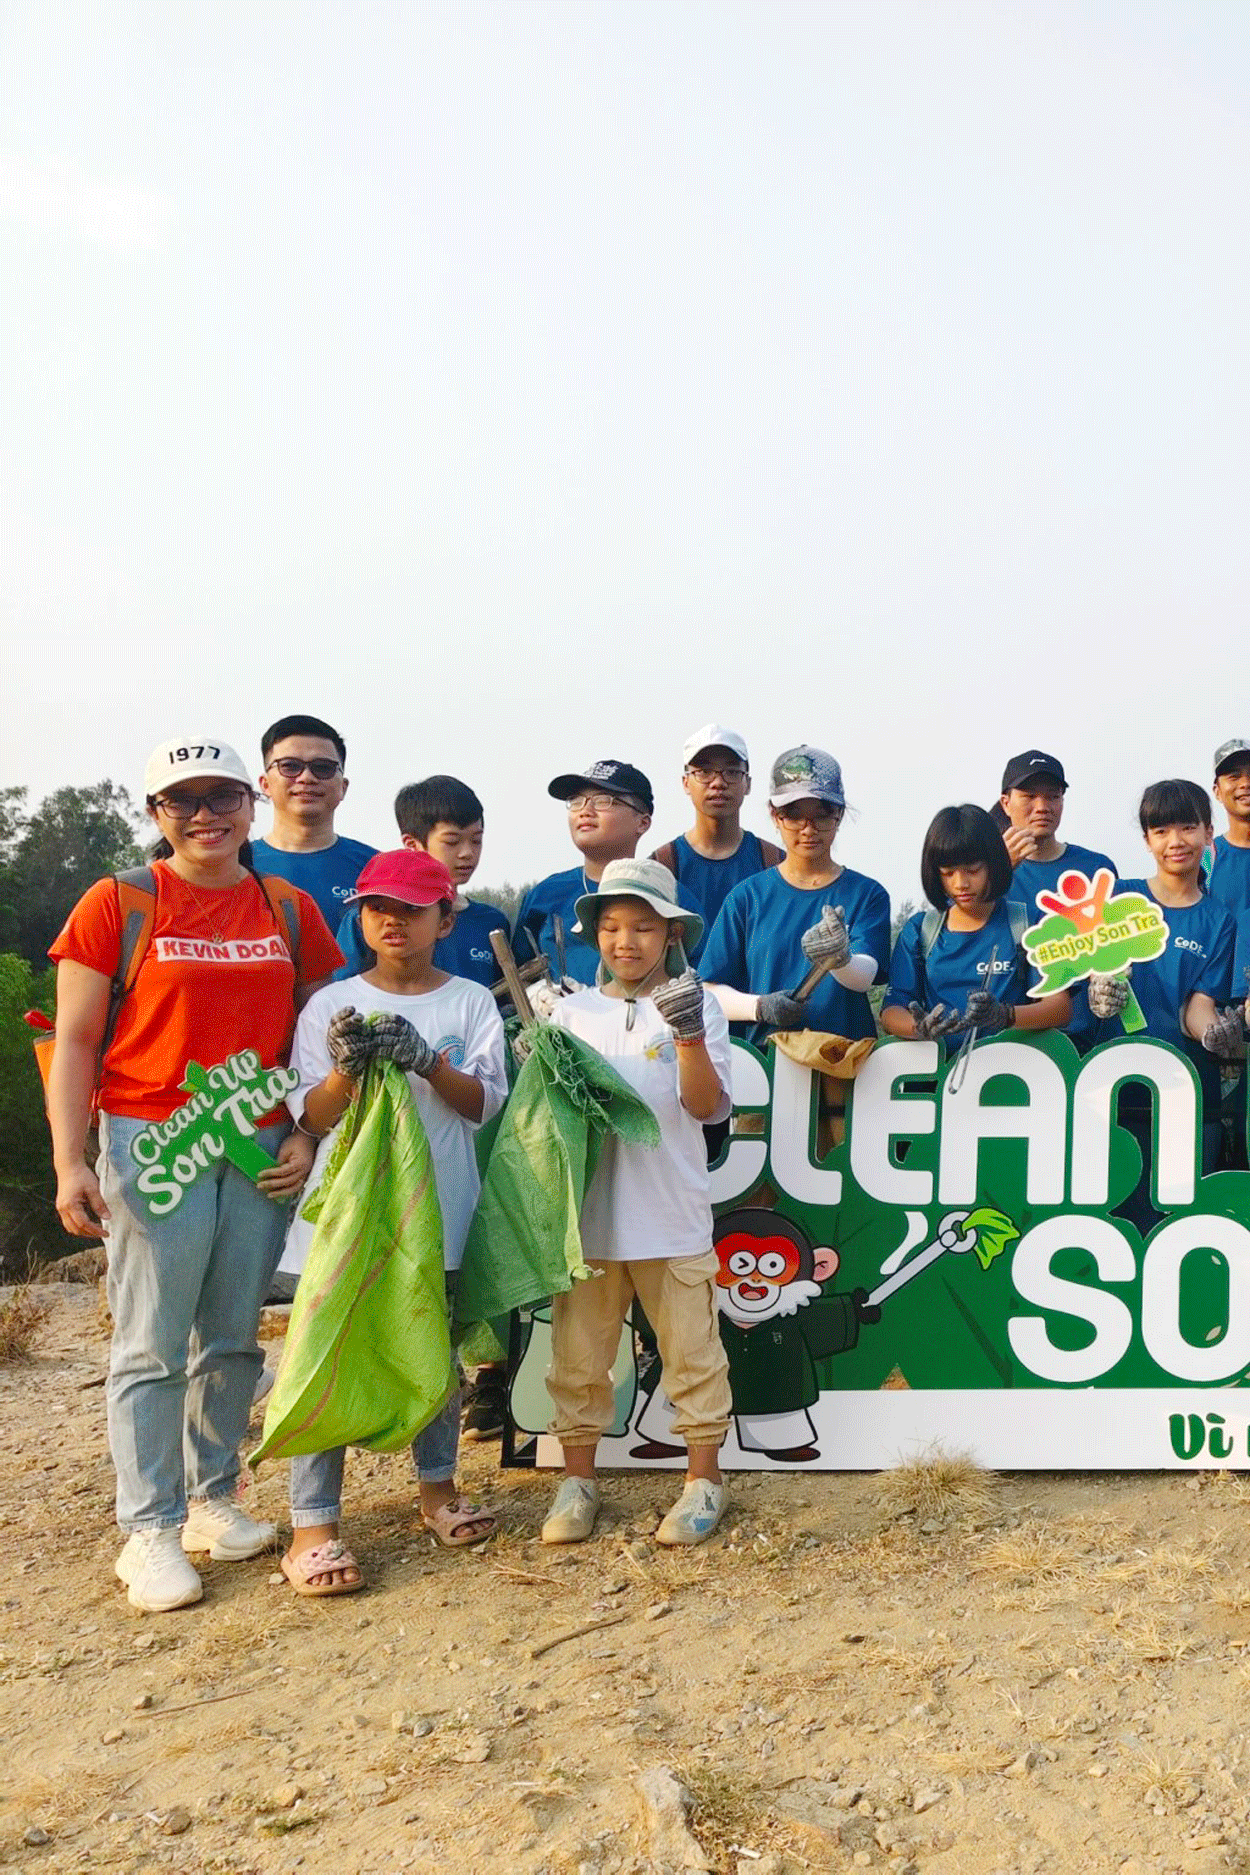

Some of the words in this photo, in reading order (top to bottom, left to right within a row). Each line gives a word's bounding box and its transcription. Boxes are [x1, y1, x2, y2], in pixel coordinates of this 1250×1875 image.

[169, 745, 221, 764] 1977
[331, 886, 359, 898] CoD
[163, 939, 230, 960] KEVIN
[1037, 934, 1095, 962] #Enjoy
[1097, 921, 1131, 945] Son
[1131, 913, 1159, 932] Tra
[132, 1091, 215, 1165] Clean
[208, 1051, 258, 1090] Up
[707, 1042, 1196, 1206] CLEAN
[137, 1132, 225, 1215] Son
[213, 1067, 299, 1136] Tra
[1168, 1412, 1234, 1459] Vì
